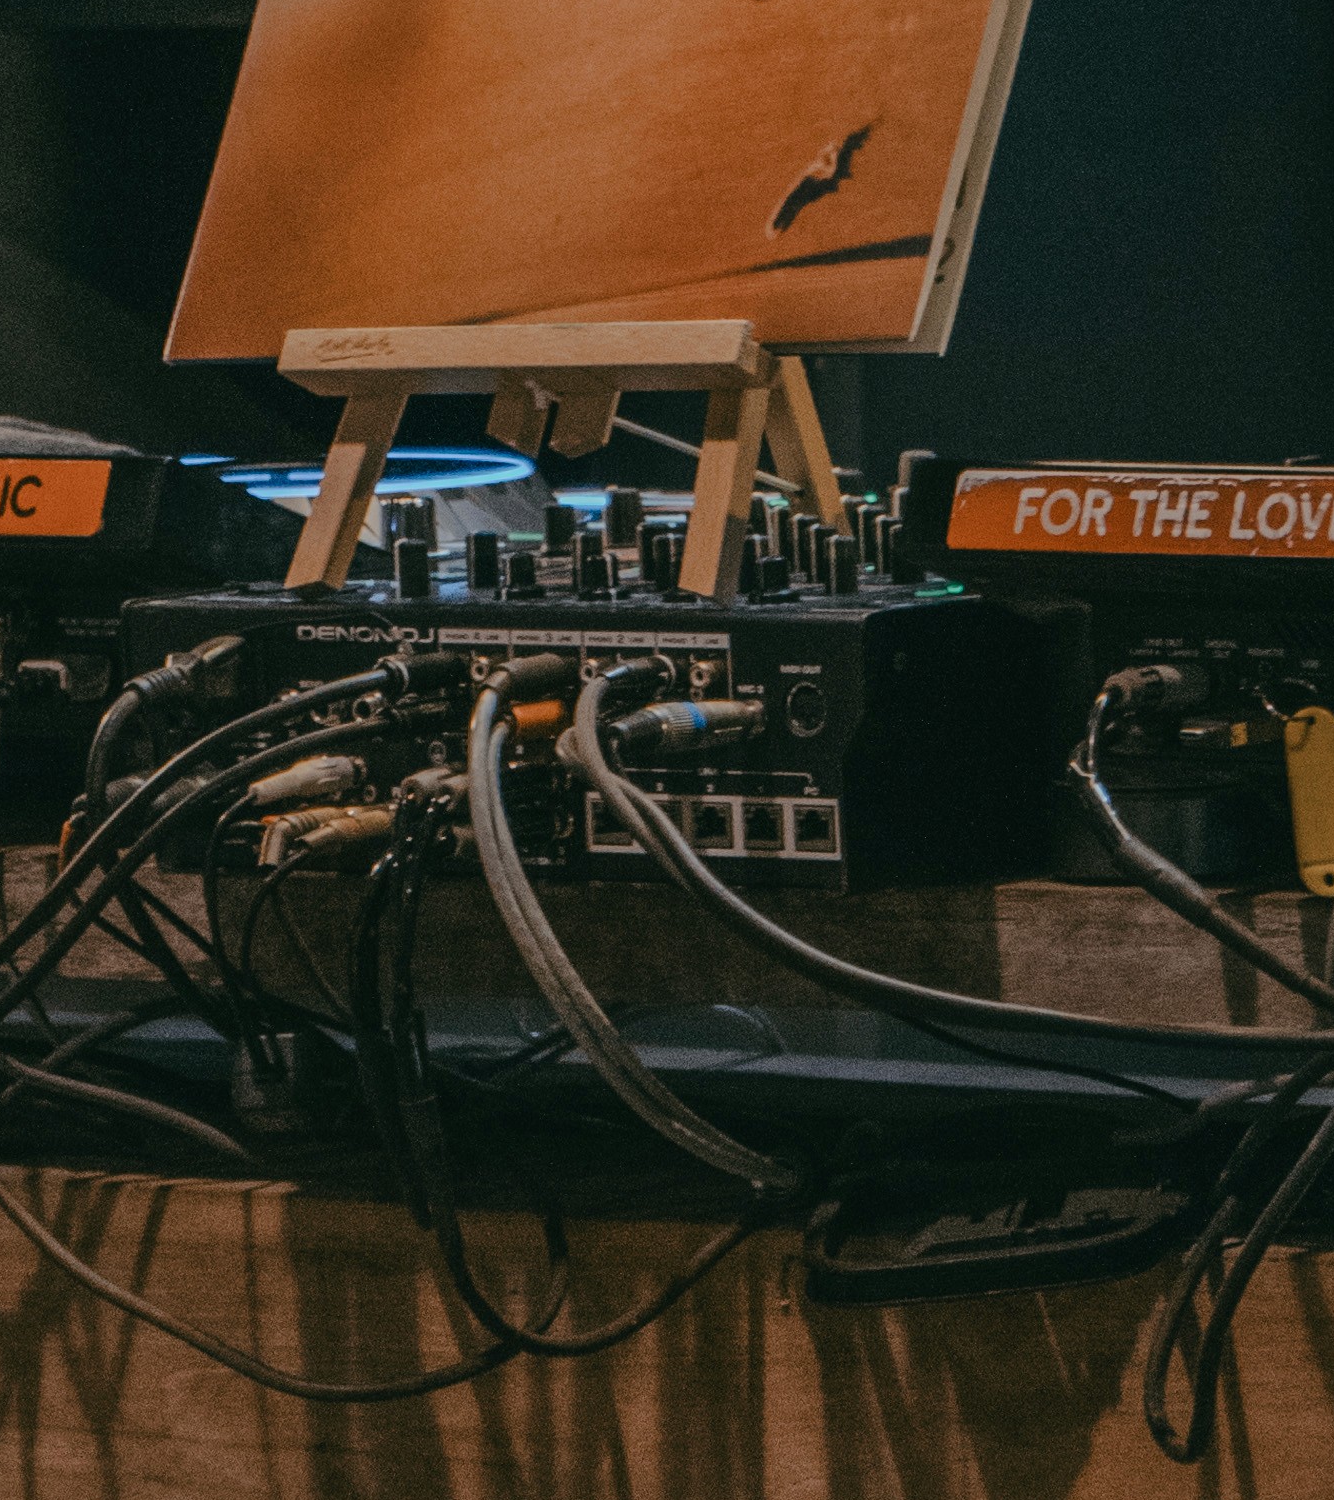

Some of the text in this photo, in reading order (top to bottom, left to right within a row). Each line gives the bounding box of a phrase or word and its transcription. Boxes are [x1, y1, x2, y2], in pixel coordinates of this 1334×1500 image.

[1013, 487, 1113, 536] FOR
[1129, 489, 1219, 539] THE
[296, 624, 394, 643] DENON
